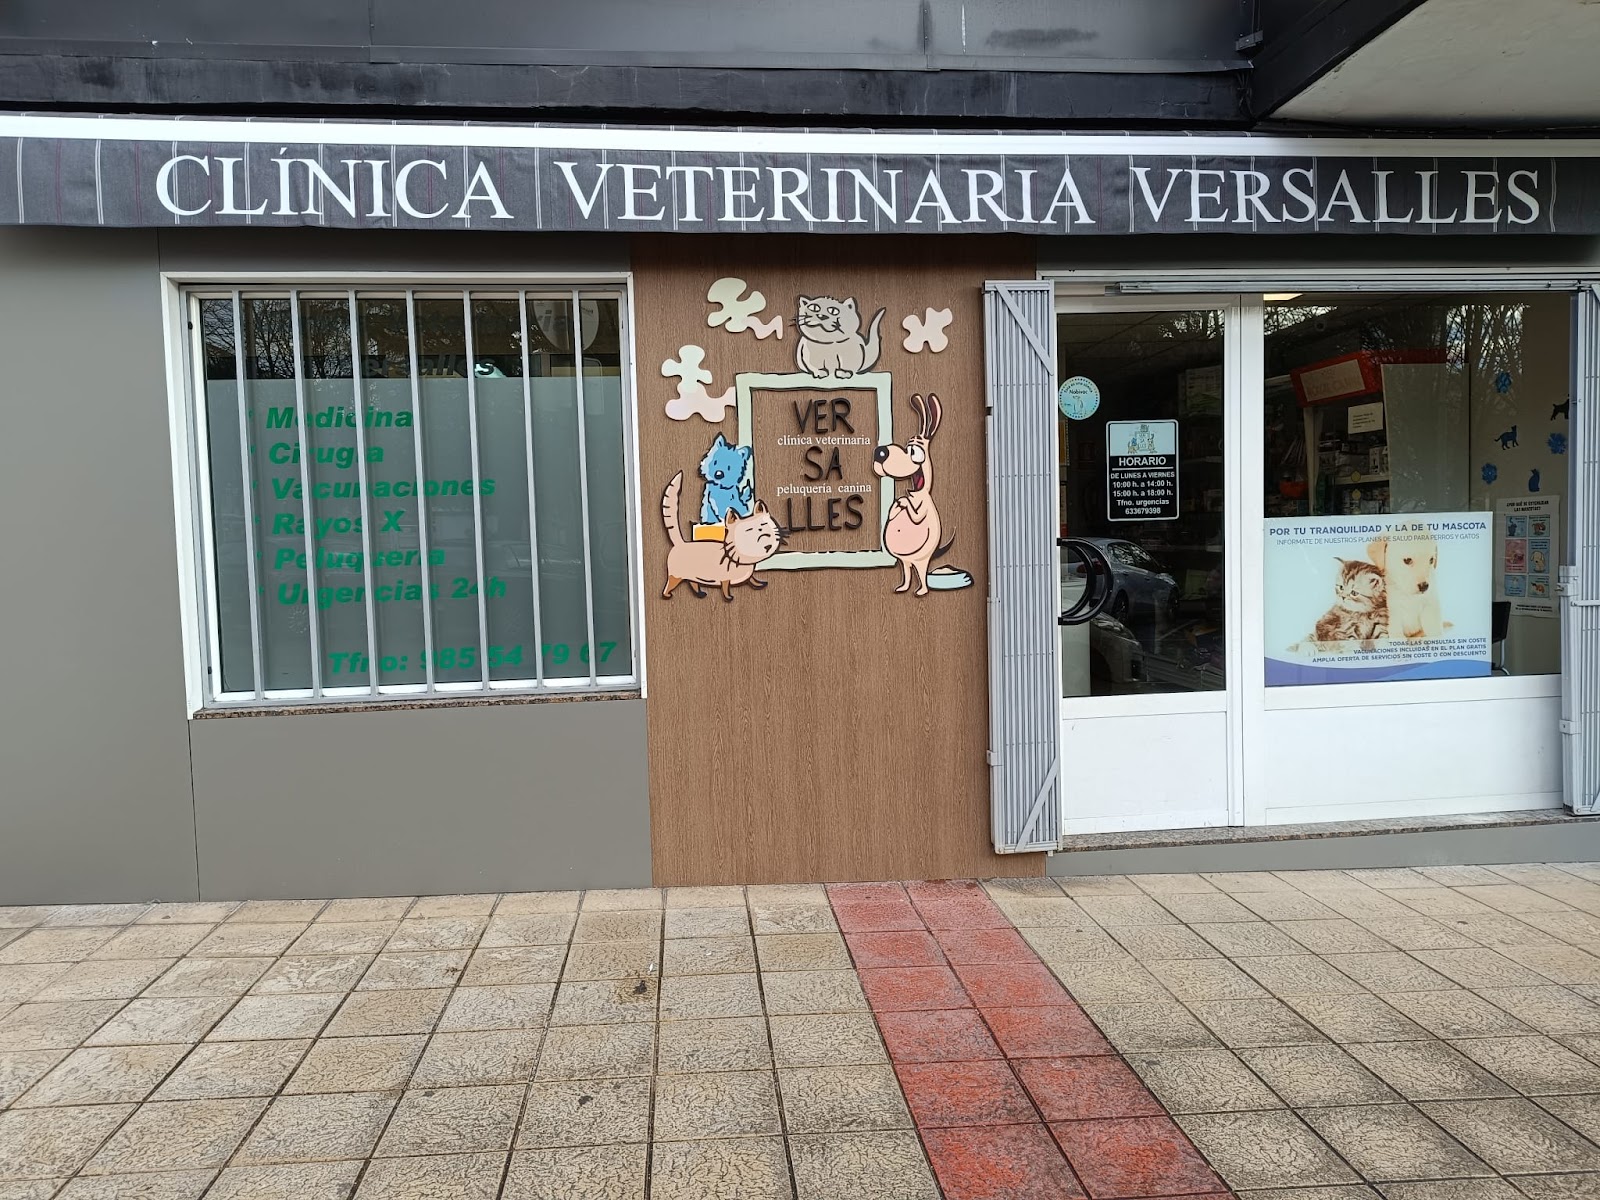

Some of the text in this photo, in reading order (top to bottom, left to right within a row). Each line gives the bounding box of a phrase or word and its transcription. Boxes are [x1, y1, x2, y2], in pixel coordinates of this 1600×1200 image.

[155, 147, 1541, 227] CLÍNICA VETERINARIA VERSALLES
[793, 397, 855, 434] VER
[777, 434, 871, 446] clínica veterinaria
[268, 441, 385, 469] Ciuga
[1118, 456, 1167, 467] HORARIO
[804, 445, 843, 481] SA
[1110, 472, 1120, 480] DE
[776, 483, 872, 497] peluquería canina
[1112, 480, 1131, 488] 10:00
[1132, 480, 1140, 488] h.
[1166, 479, 1174, 487] h.
[1112, 489, 1131, 497] 15:00
[1132, 489, 1140, 497] h.
[1166, 488, 1174, 496] h.
[1135, 498, 1170, 507] urgencias
[786, 494, 864, 532] LLES
[379, 510, 405, 533] X
[1269, 522, 1487, 536] POR TU TRANQUILIDAD Y LA DE TU MASCOTA
[1358, 535, 1382, 543] PLANES
[274, 546, 447, 573] Peluquera
[487, 644, 524, 668] 54
